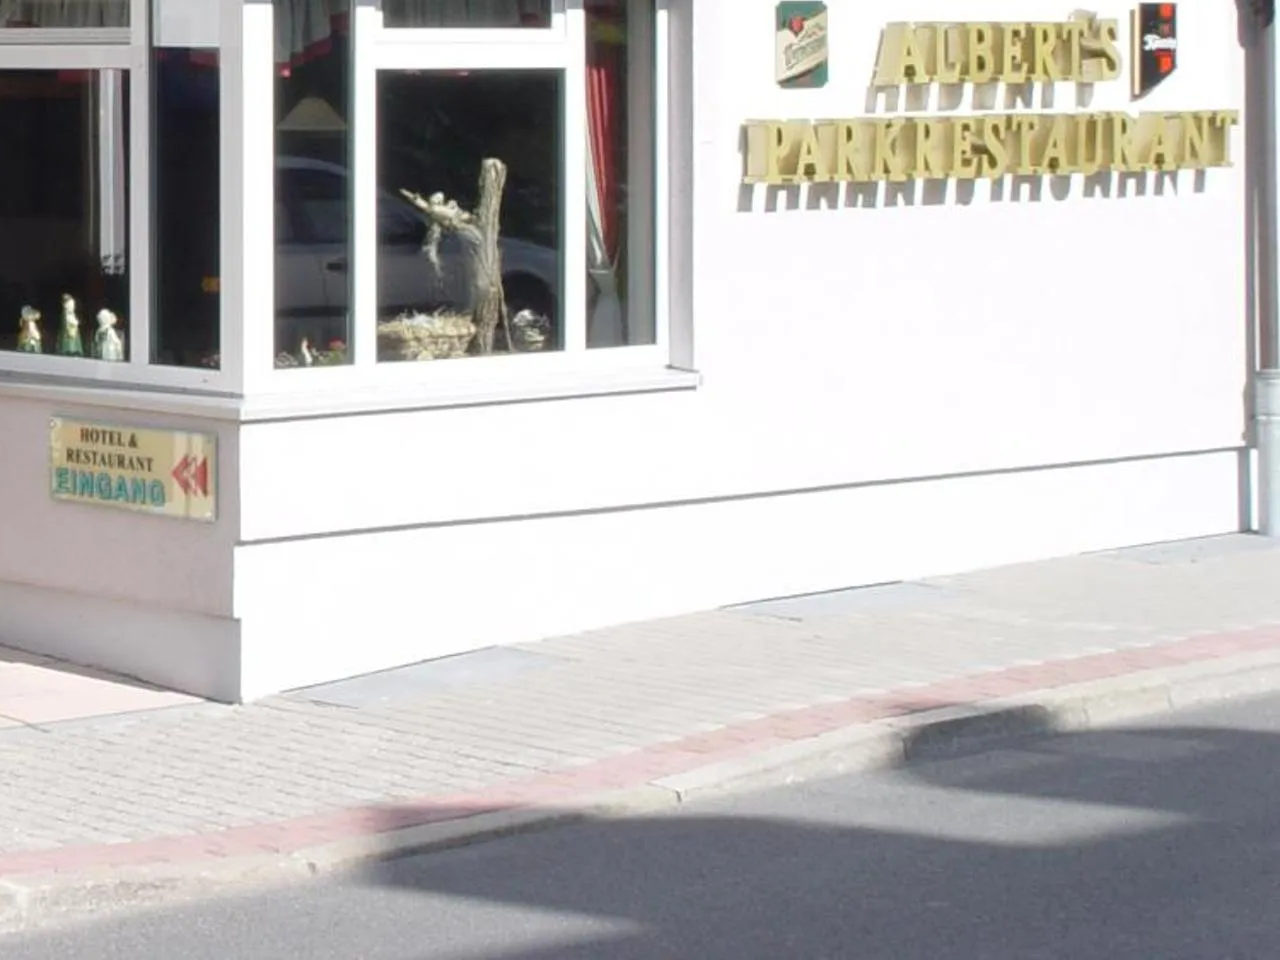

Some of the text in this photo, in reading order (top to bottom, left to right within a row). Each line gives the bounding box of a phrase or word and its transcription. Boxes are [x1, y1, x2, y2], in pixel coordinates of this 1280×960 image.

[748, 109, 1239, 184] PARKRESTAURANT
[80, 427, 138, 448] HOTEL &
[65, 448, 154, 472] RESTAURANT
[55, 467, 167, 507] EINGANG
